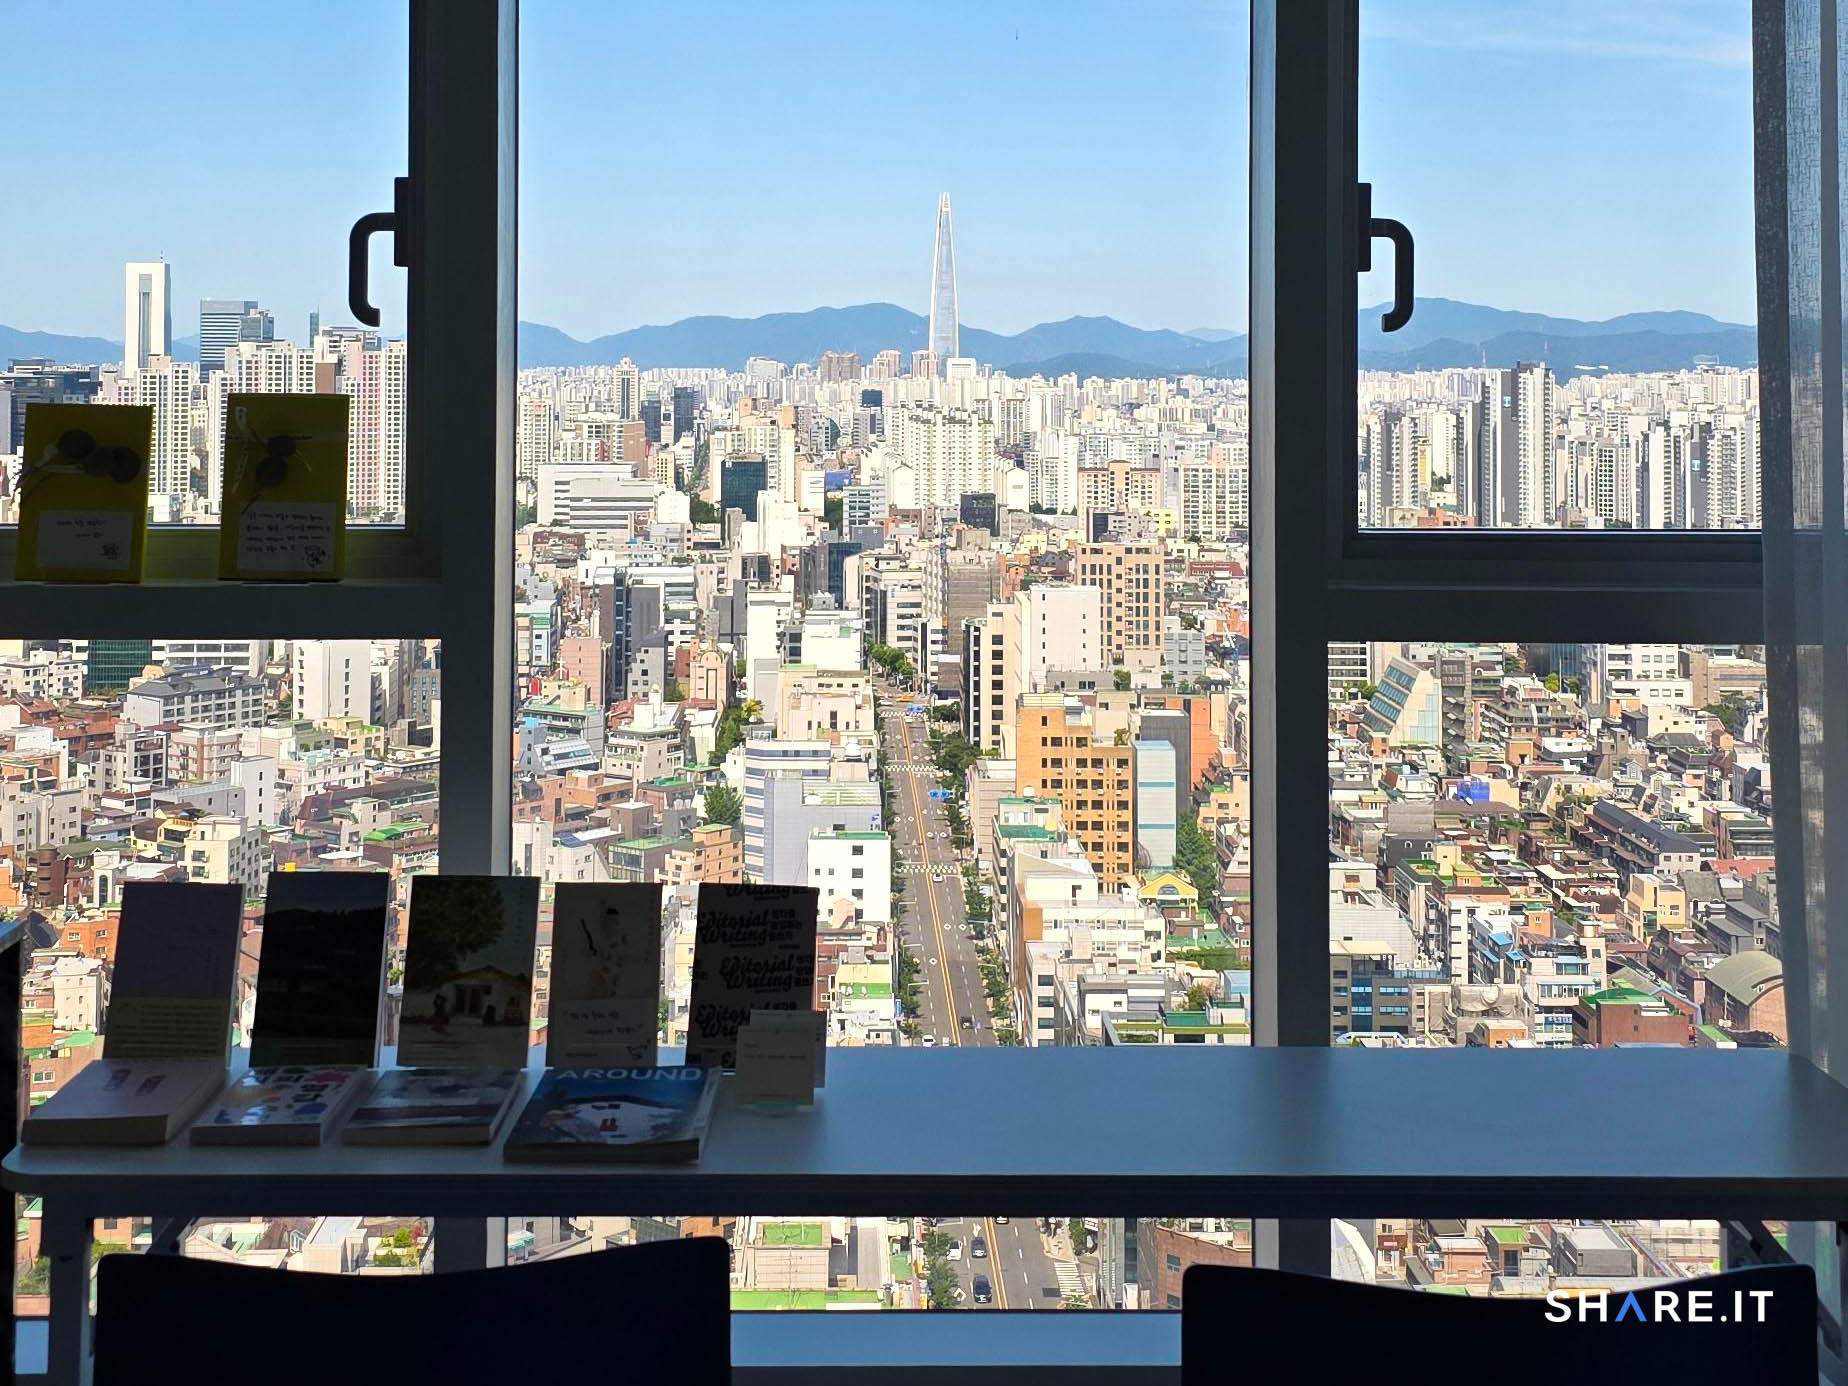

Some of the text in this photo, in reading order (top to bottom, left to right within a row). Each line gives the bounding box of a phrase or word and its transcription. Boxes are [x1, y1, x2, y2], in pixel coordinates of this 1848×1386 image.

[697, 909, 768, 930] Editorial
[720, 954, 794, 976] Editorial
[725, 973, 794, 991] Writing
[556, 1068, 702, 1081] AROUND
